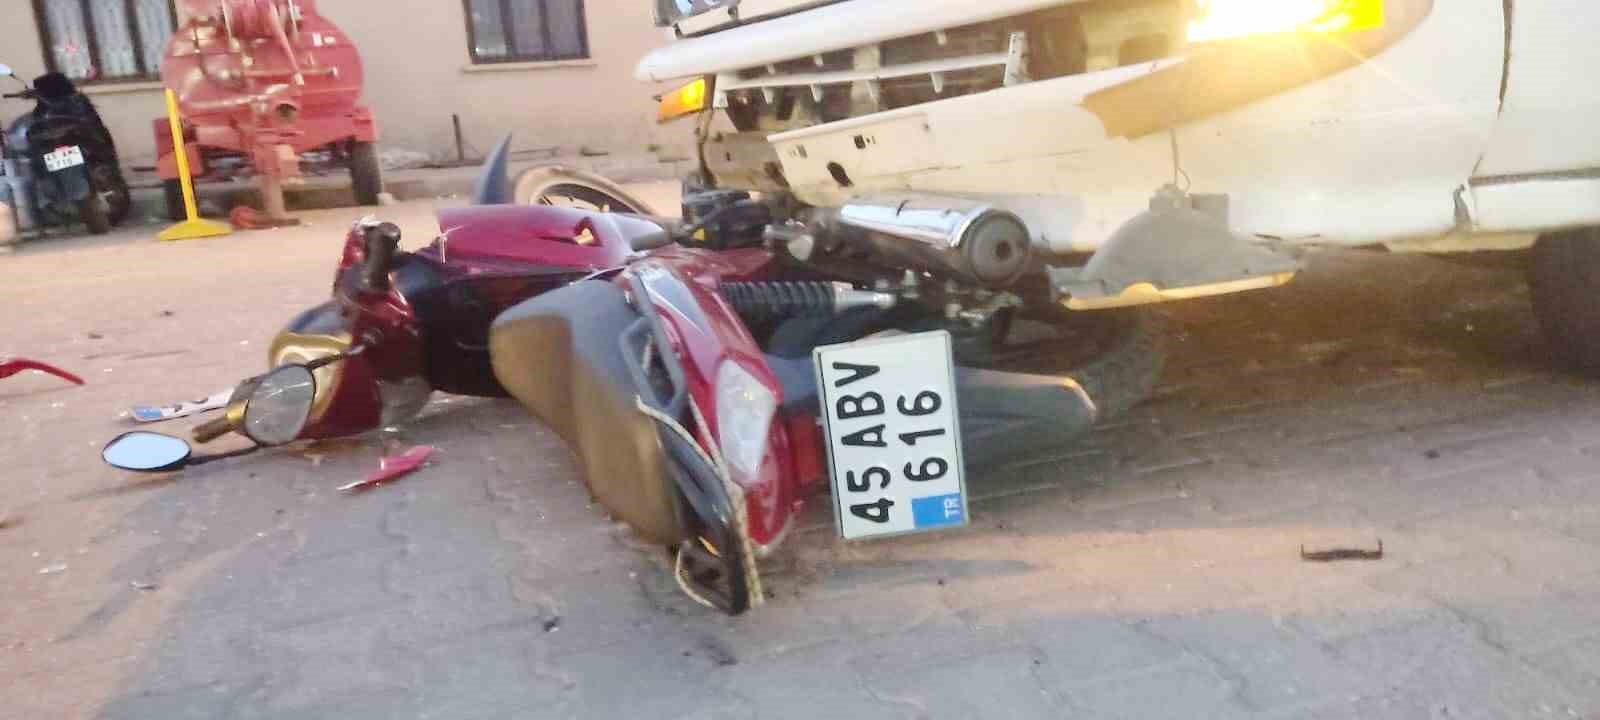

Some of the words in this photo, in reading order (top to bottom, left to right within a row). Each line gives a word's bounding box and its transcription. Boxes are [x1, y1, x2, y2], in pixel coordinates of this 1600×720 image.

[832, 361, 887, 447] ABV
[896, 390, 948, 482] 616
[846, 466, 894, 523] 45
[944, 497, 960, 518] TR
